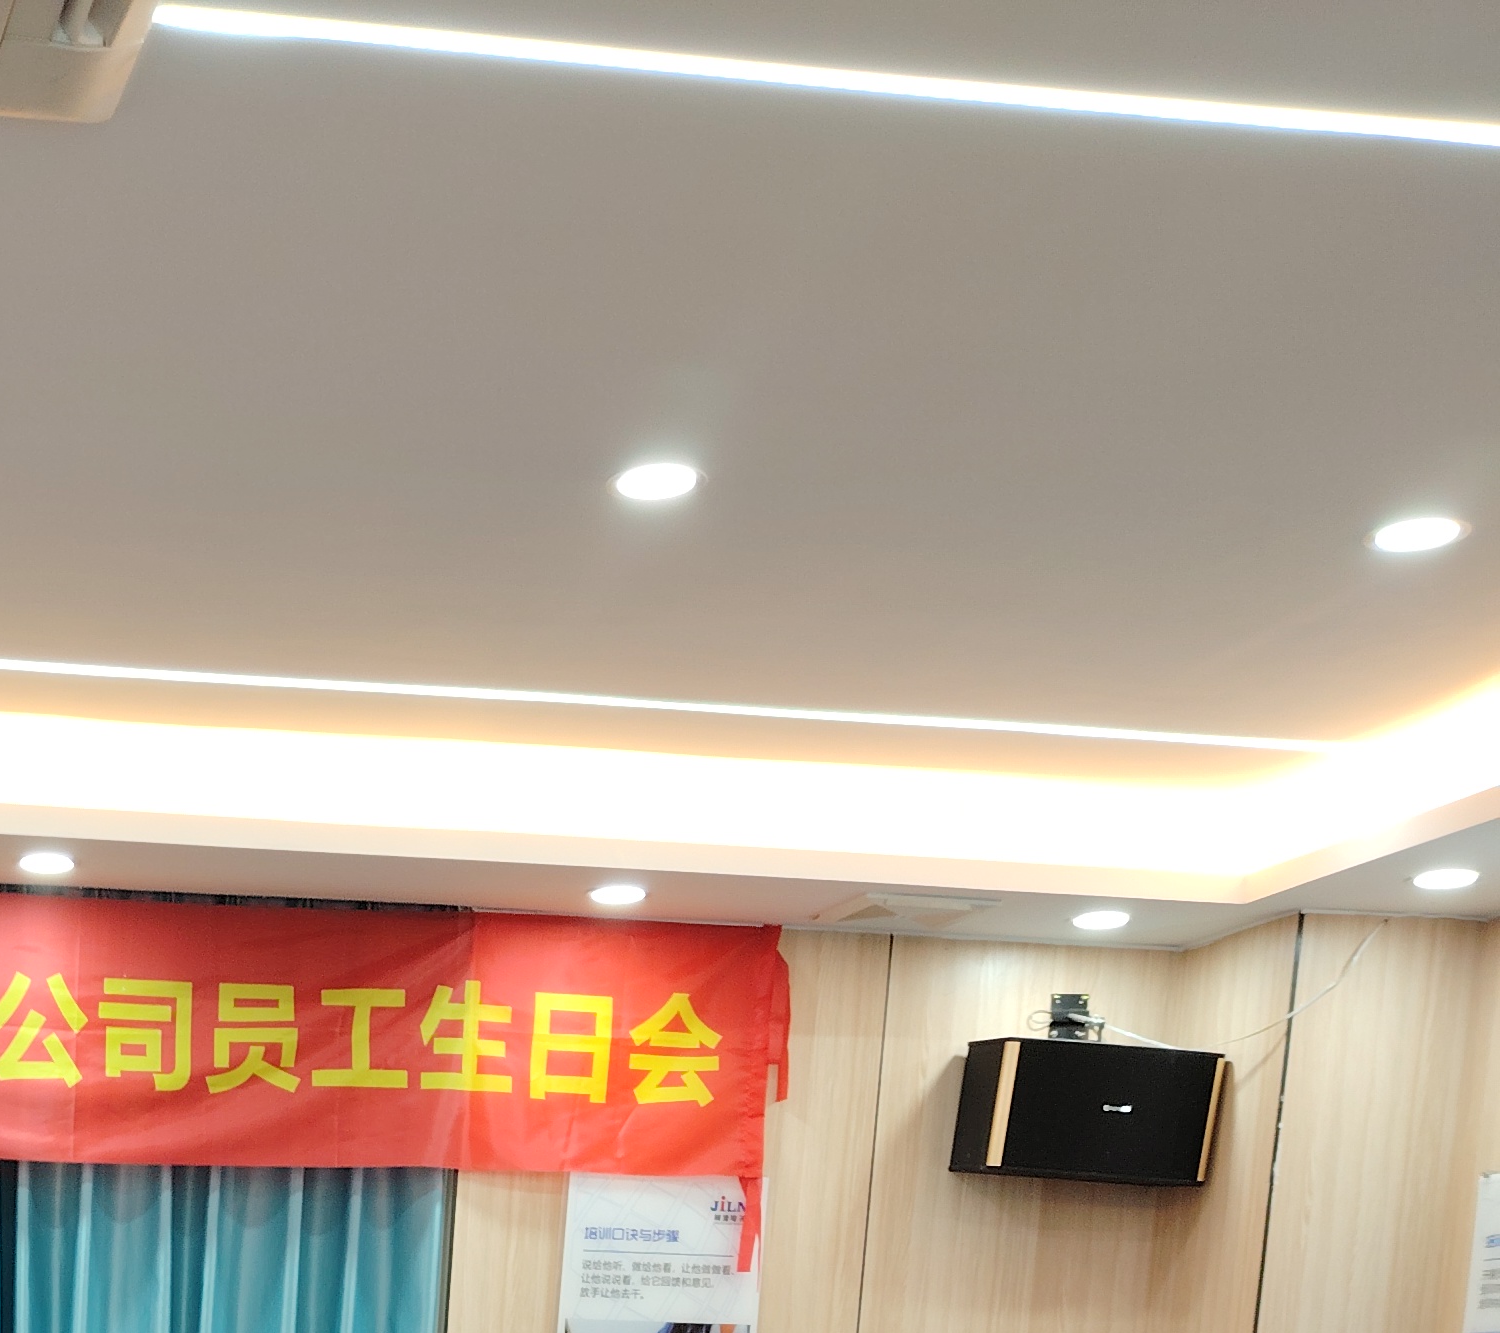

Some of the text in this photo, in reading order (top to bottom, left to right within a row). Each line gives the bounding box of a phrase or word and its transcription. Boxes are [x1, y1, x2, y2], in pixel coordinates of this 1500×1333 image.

[584, 1226, 679, 1242] 培训口诀与步骤
